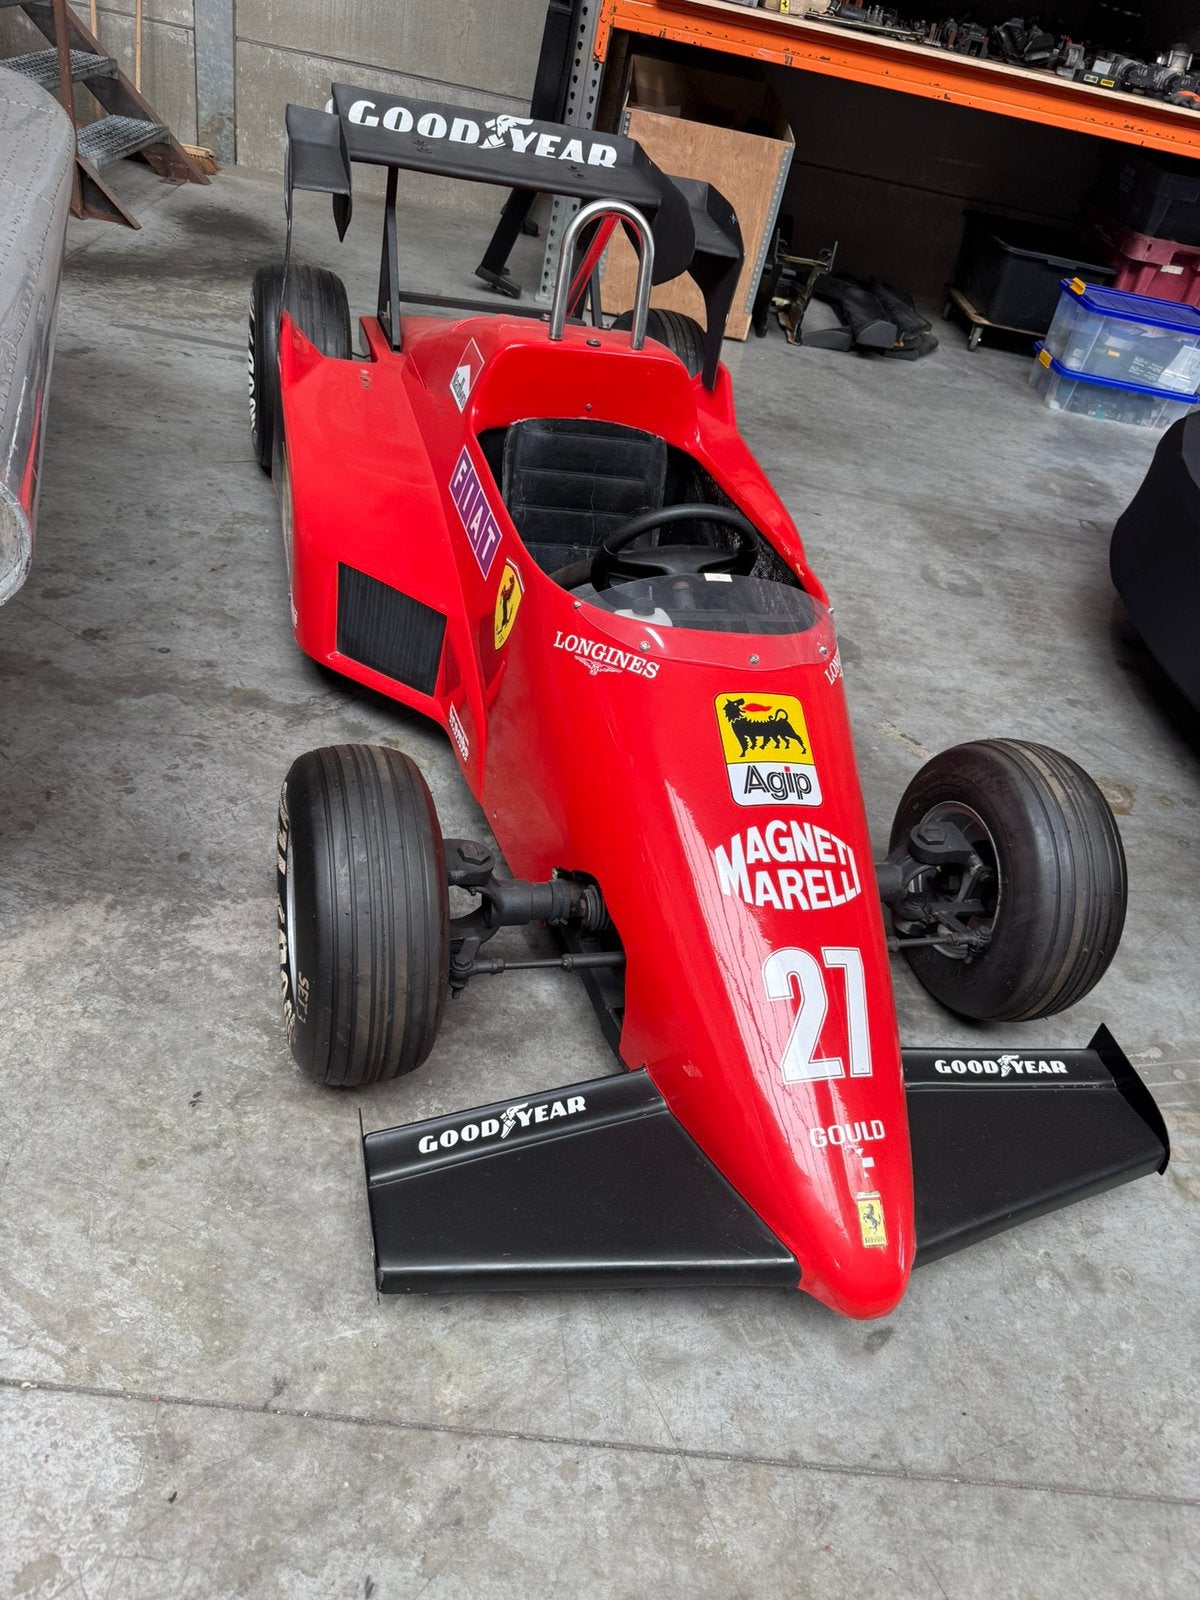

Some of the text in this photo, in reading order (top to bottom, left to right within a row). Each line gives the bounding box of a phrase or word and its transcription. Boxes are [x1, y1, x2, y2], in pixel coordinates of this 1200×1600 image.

[453, 459, 496, 561] FIAT
[553, 631, 661, 679] LONGINES
[744, 765, 812, 801] Agip
[714, 819, 861, 900] MAGNETI
[714, 837, 861, 911] MARELLI
[762, 946, 873, 1085] 27
[809, 1119, 886, 1149] GOULD
